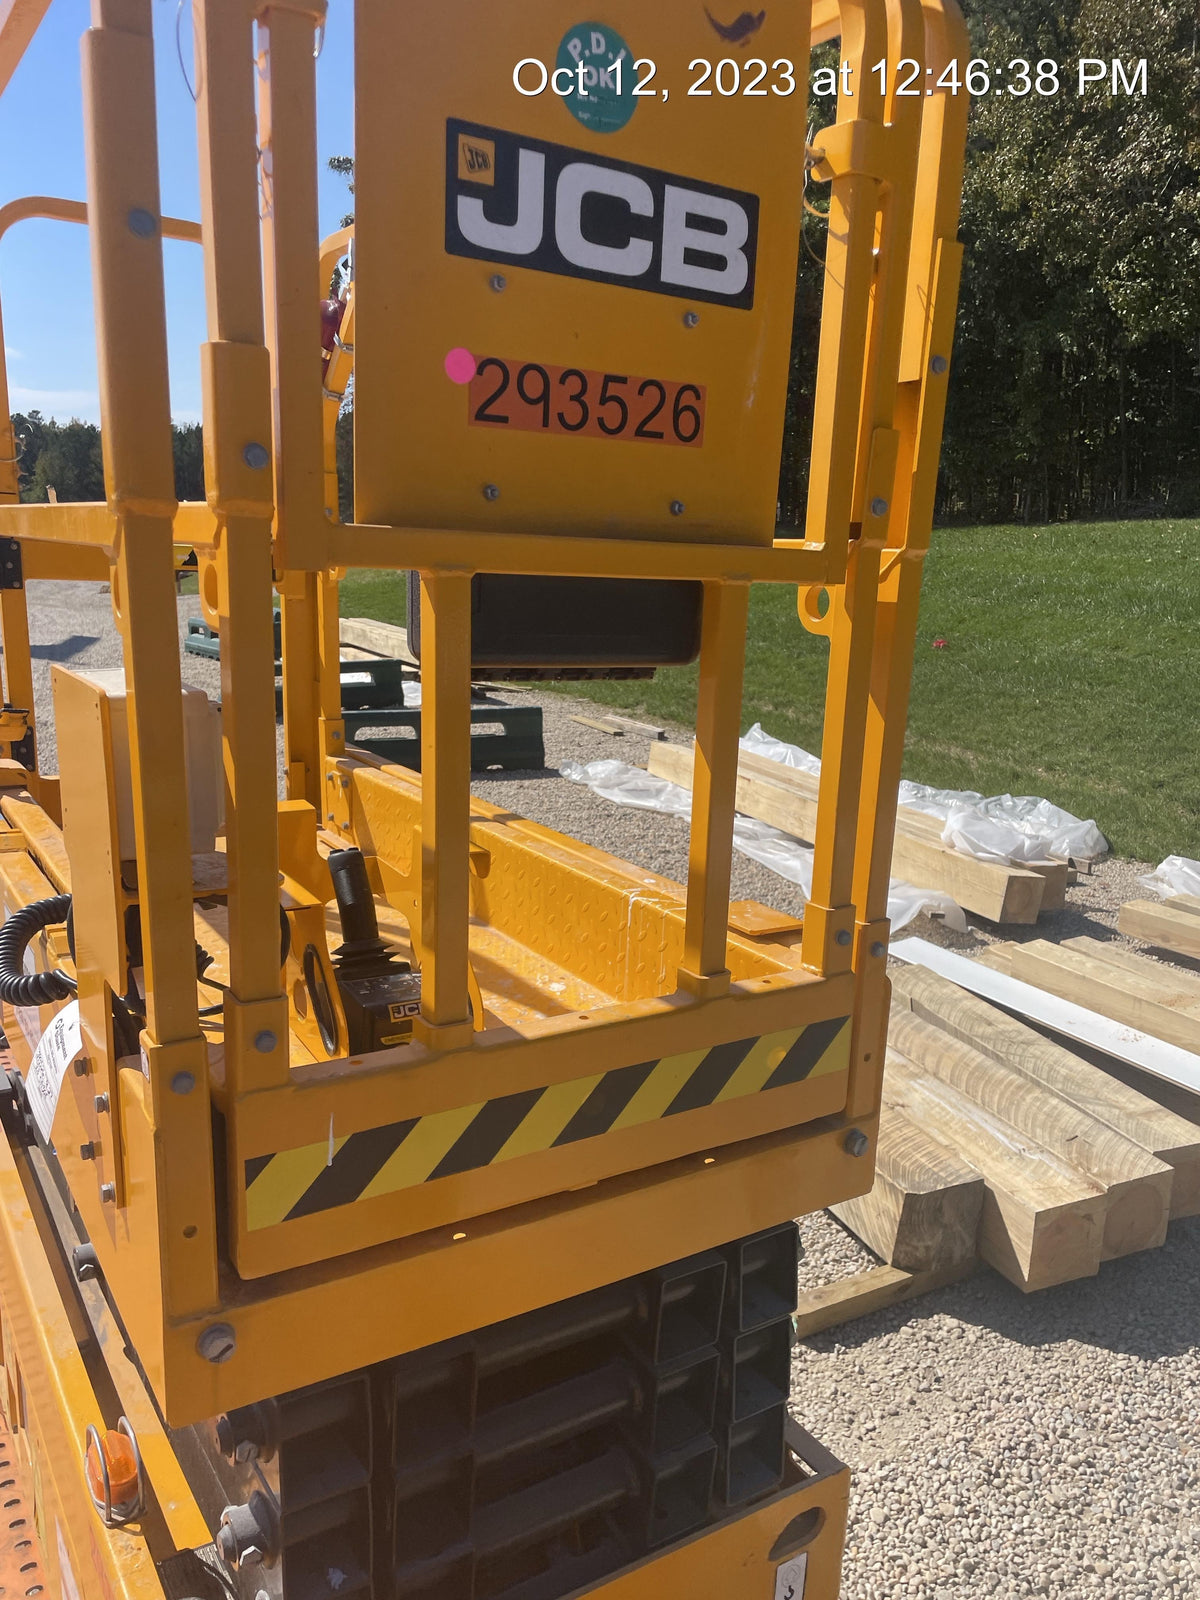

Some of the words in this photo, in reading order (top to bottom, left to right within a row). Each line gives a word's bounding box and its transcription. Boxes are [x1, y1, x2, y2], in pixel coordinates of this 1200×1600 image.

[583, 65, 616, 89] OK
[468, 147, 491, 169] JCB
[457, 148, 749, 295] JCB
[474, 357, 701, 443] 293526
[393, 1003, 421, 1018] JC
